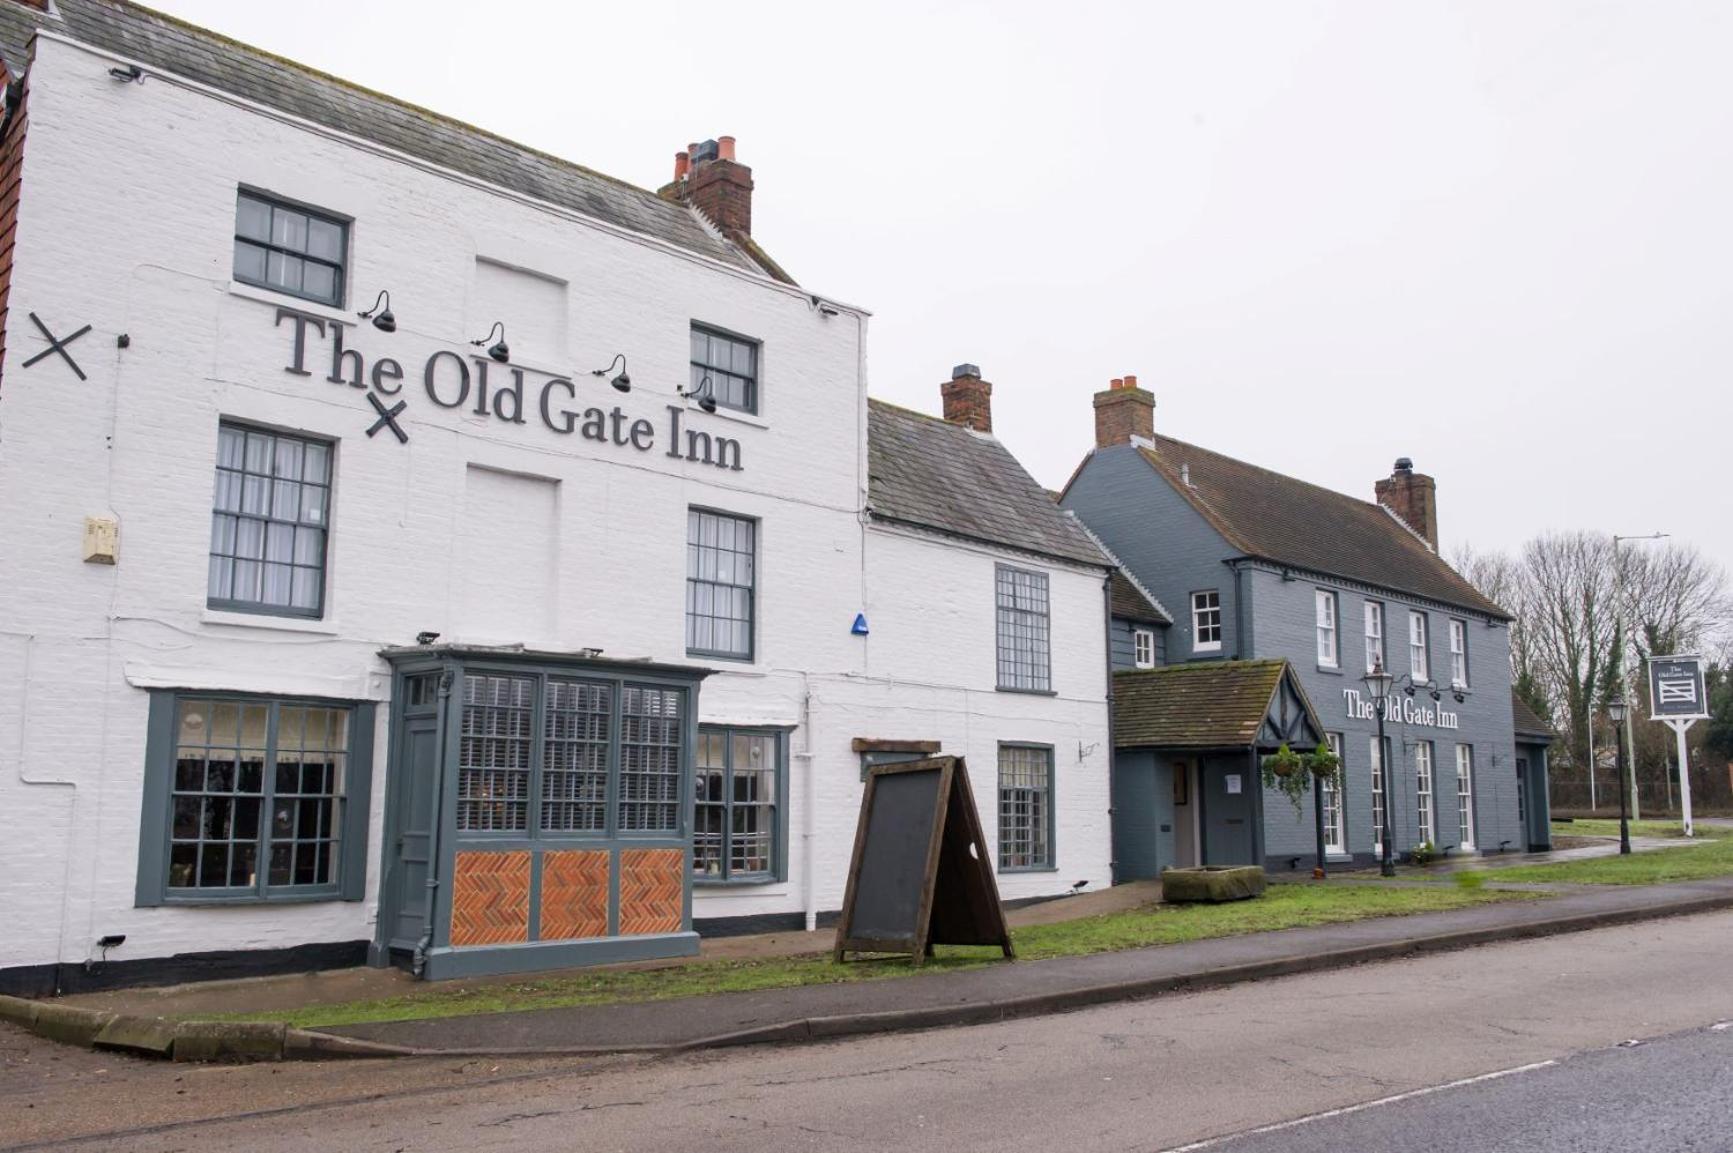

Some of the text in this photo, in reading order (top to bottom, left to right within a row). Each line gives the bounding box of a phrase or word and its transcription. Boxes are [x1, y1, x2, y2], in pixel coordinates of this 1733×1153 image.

[275, 308, 744, 471] The Old Gate Inn
[1343, 689, 1374, 720] The
[1404, 697, 1434, 726] Gate
[1434, 701, 1459, 729] Inn
